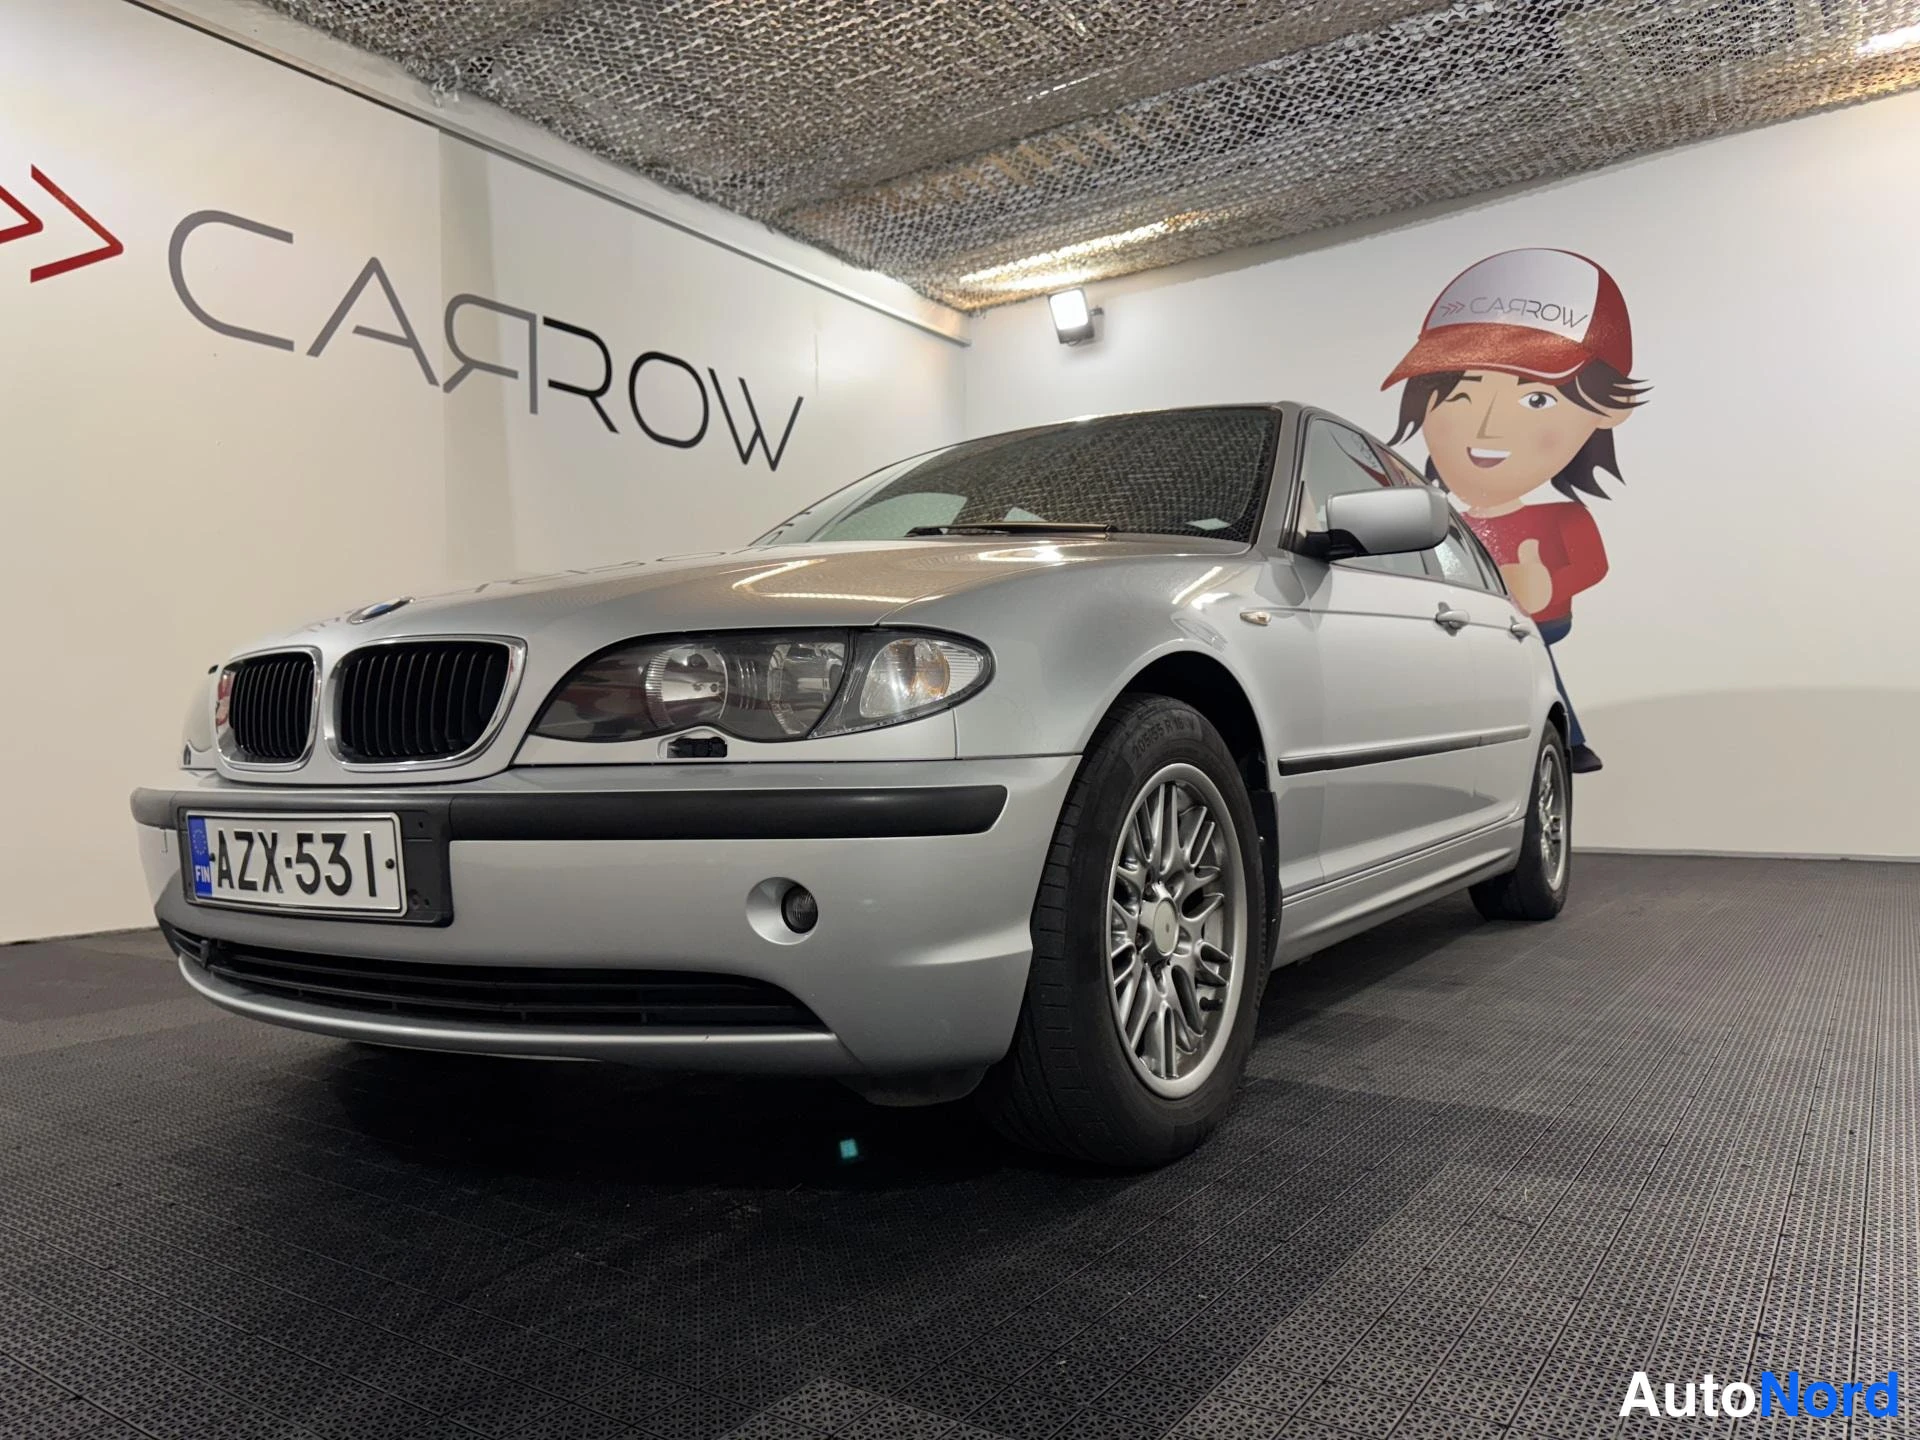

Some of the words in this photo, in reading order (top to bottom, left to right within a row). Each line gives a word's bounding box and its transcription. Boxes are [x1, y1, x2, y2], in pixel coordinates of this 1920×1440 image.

[1470, 296, 1588, 328] CARROW
[168, 209, 804, 471] CARROW
[195, 865, 211, 882] FIN
[217, 830, 377, 897] AZX-531
